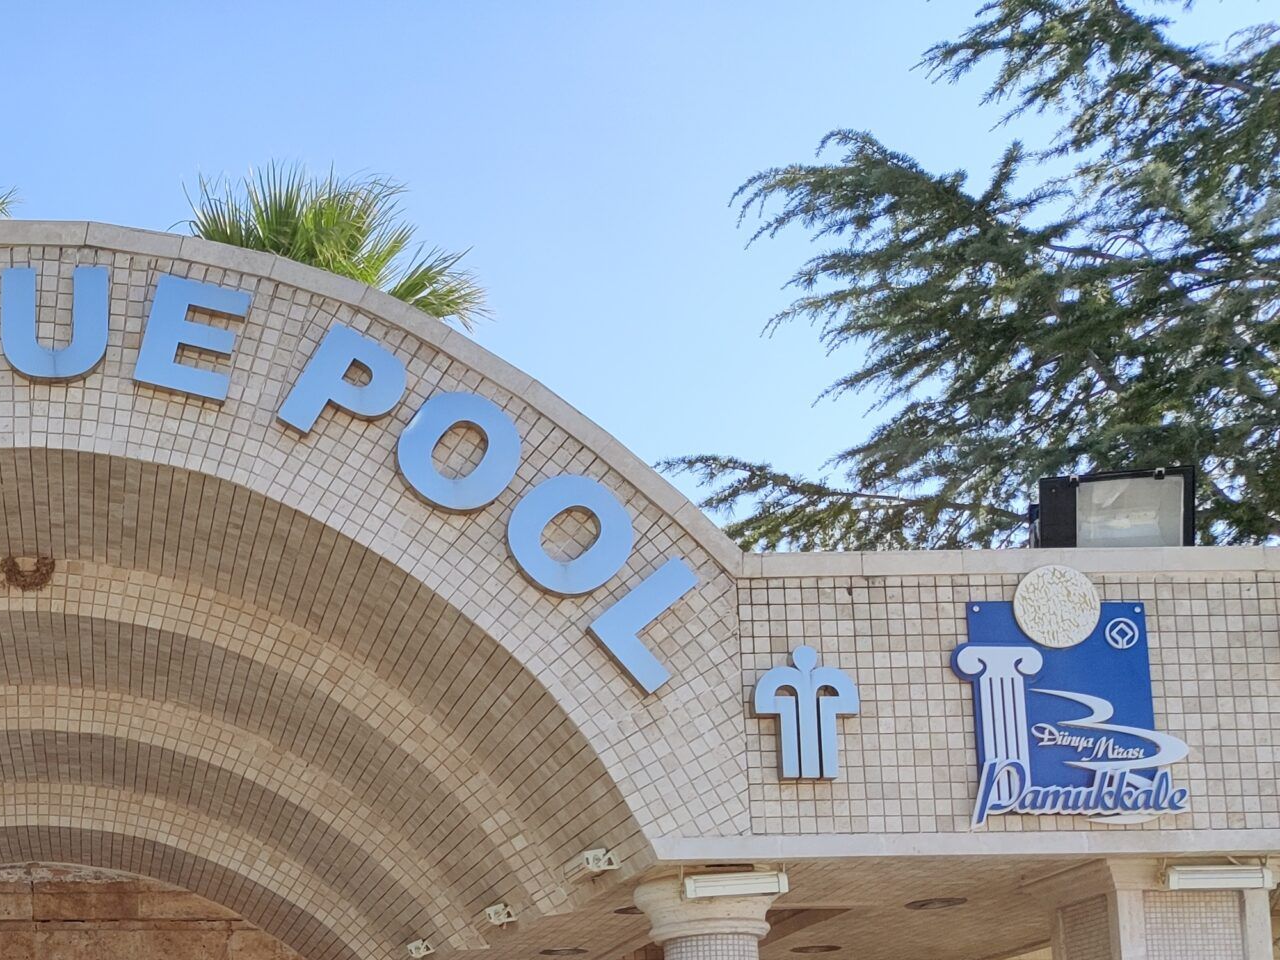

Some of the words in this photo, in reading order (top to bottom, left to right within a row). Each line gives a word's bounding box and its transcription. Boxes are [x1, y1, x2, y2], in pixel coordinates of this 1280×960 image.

[276, 325, 698, 696] POOL
[1030, 722, 1094, 753] Dünya
[973, 760, 1188, 828] Pamukkale
